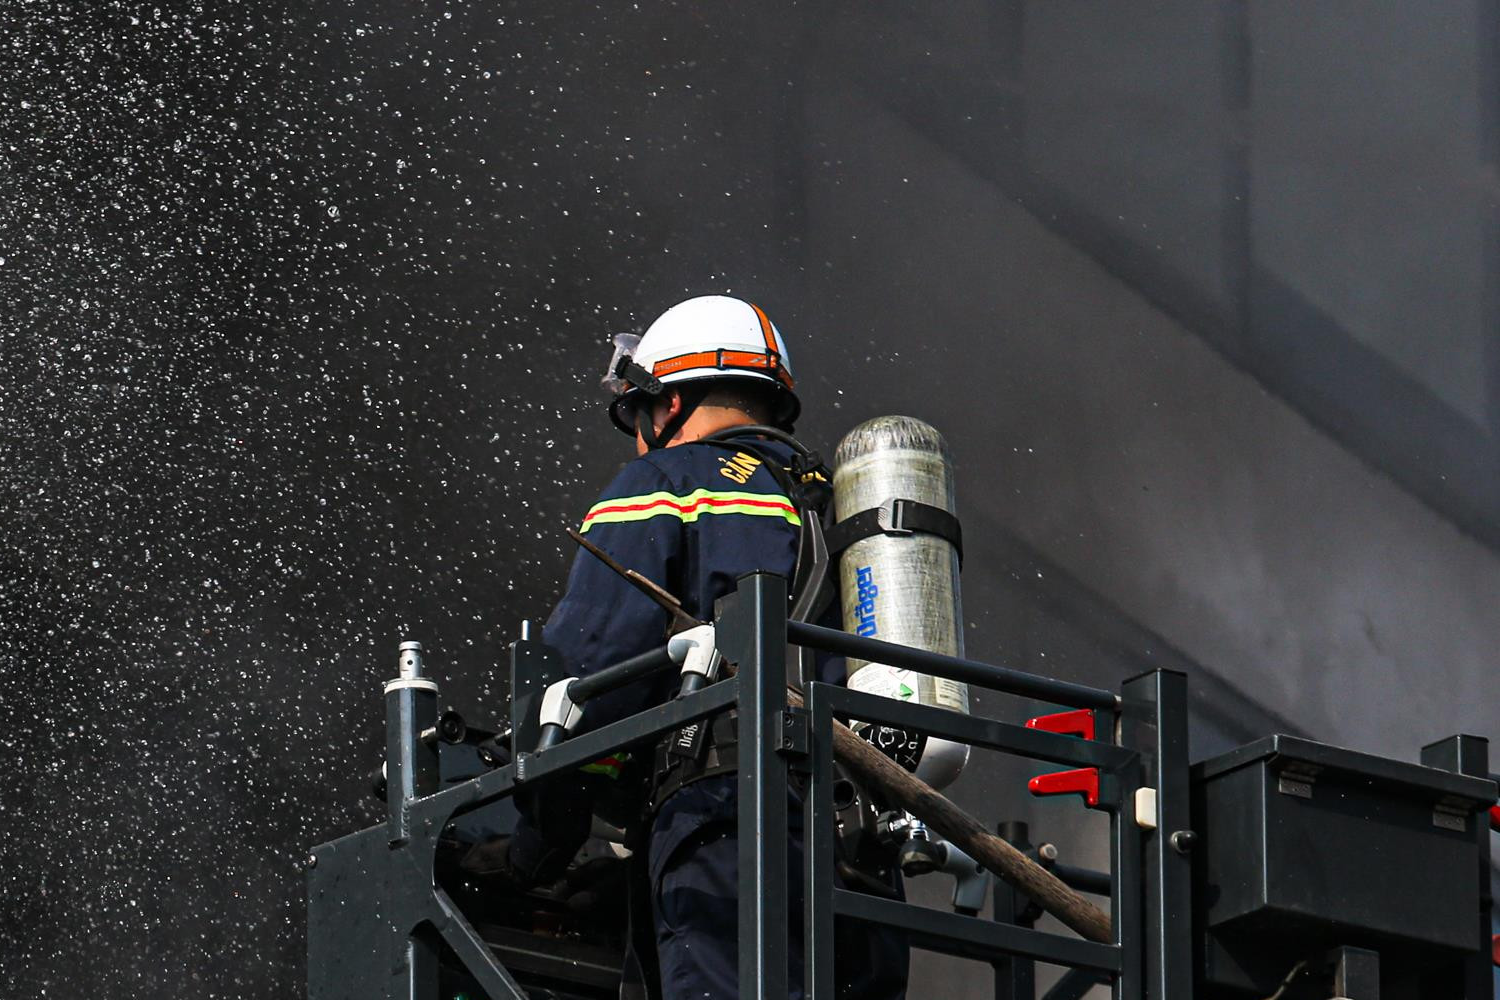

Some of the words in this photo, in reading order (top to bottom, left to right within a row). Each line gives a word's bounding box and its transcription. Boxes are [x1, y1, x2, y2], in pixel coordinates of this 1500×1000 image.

[718, 451, 761, 484] CẢN
[855, 566, 879, 637] Dräger
[677, 724, 699, 748] Dräg
